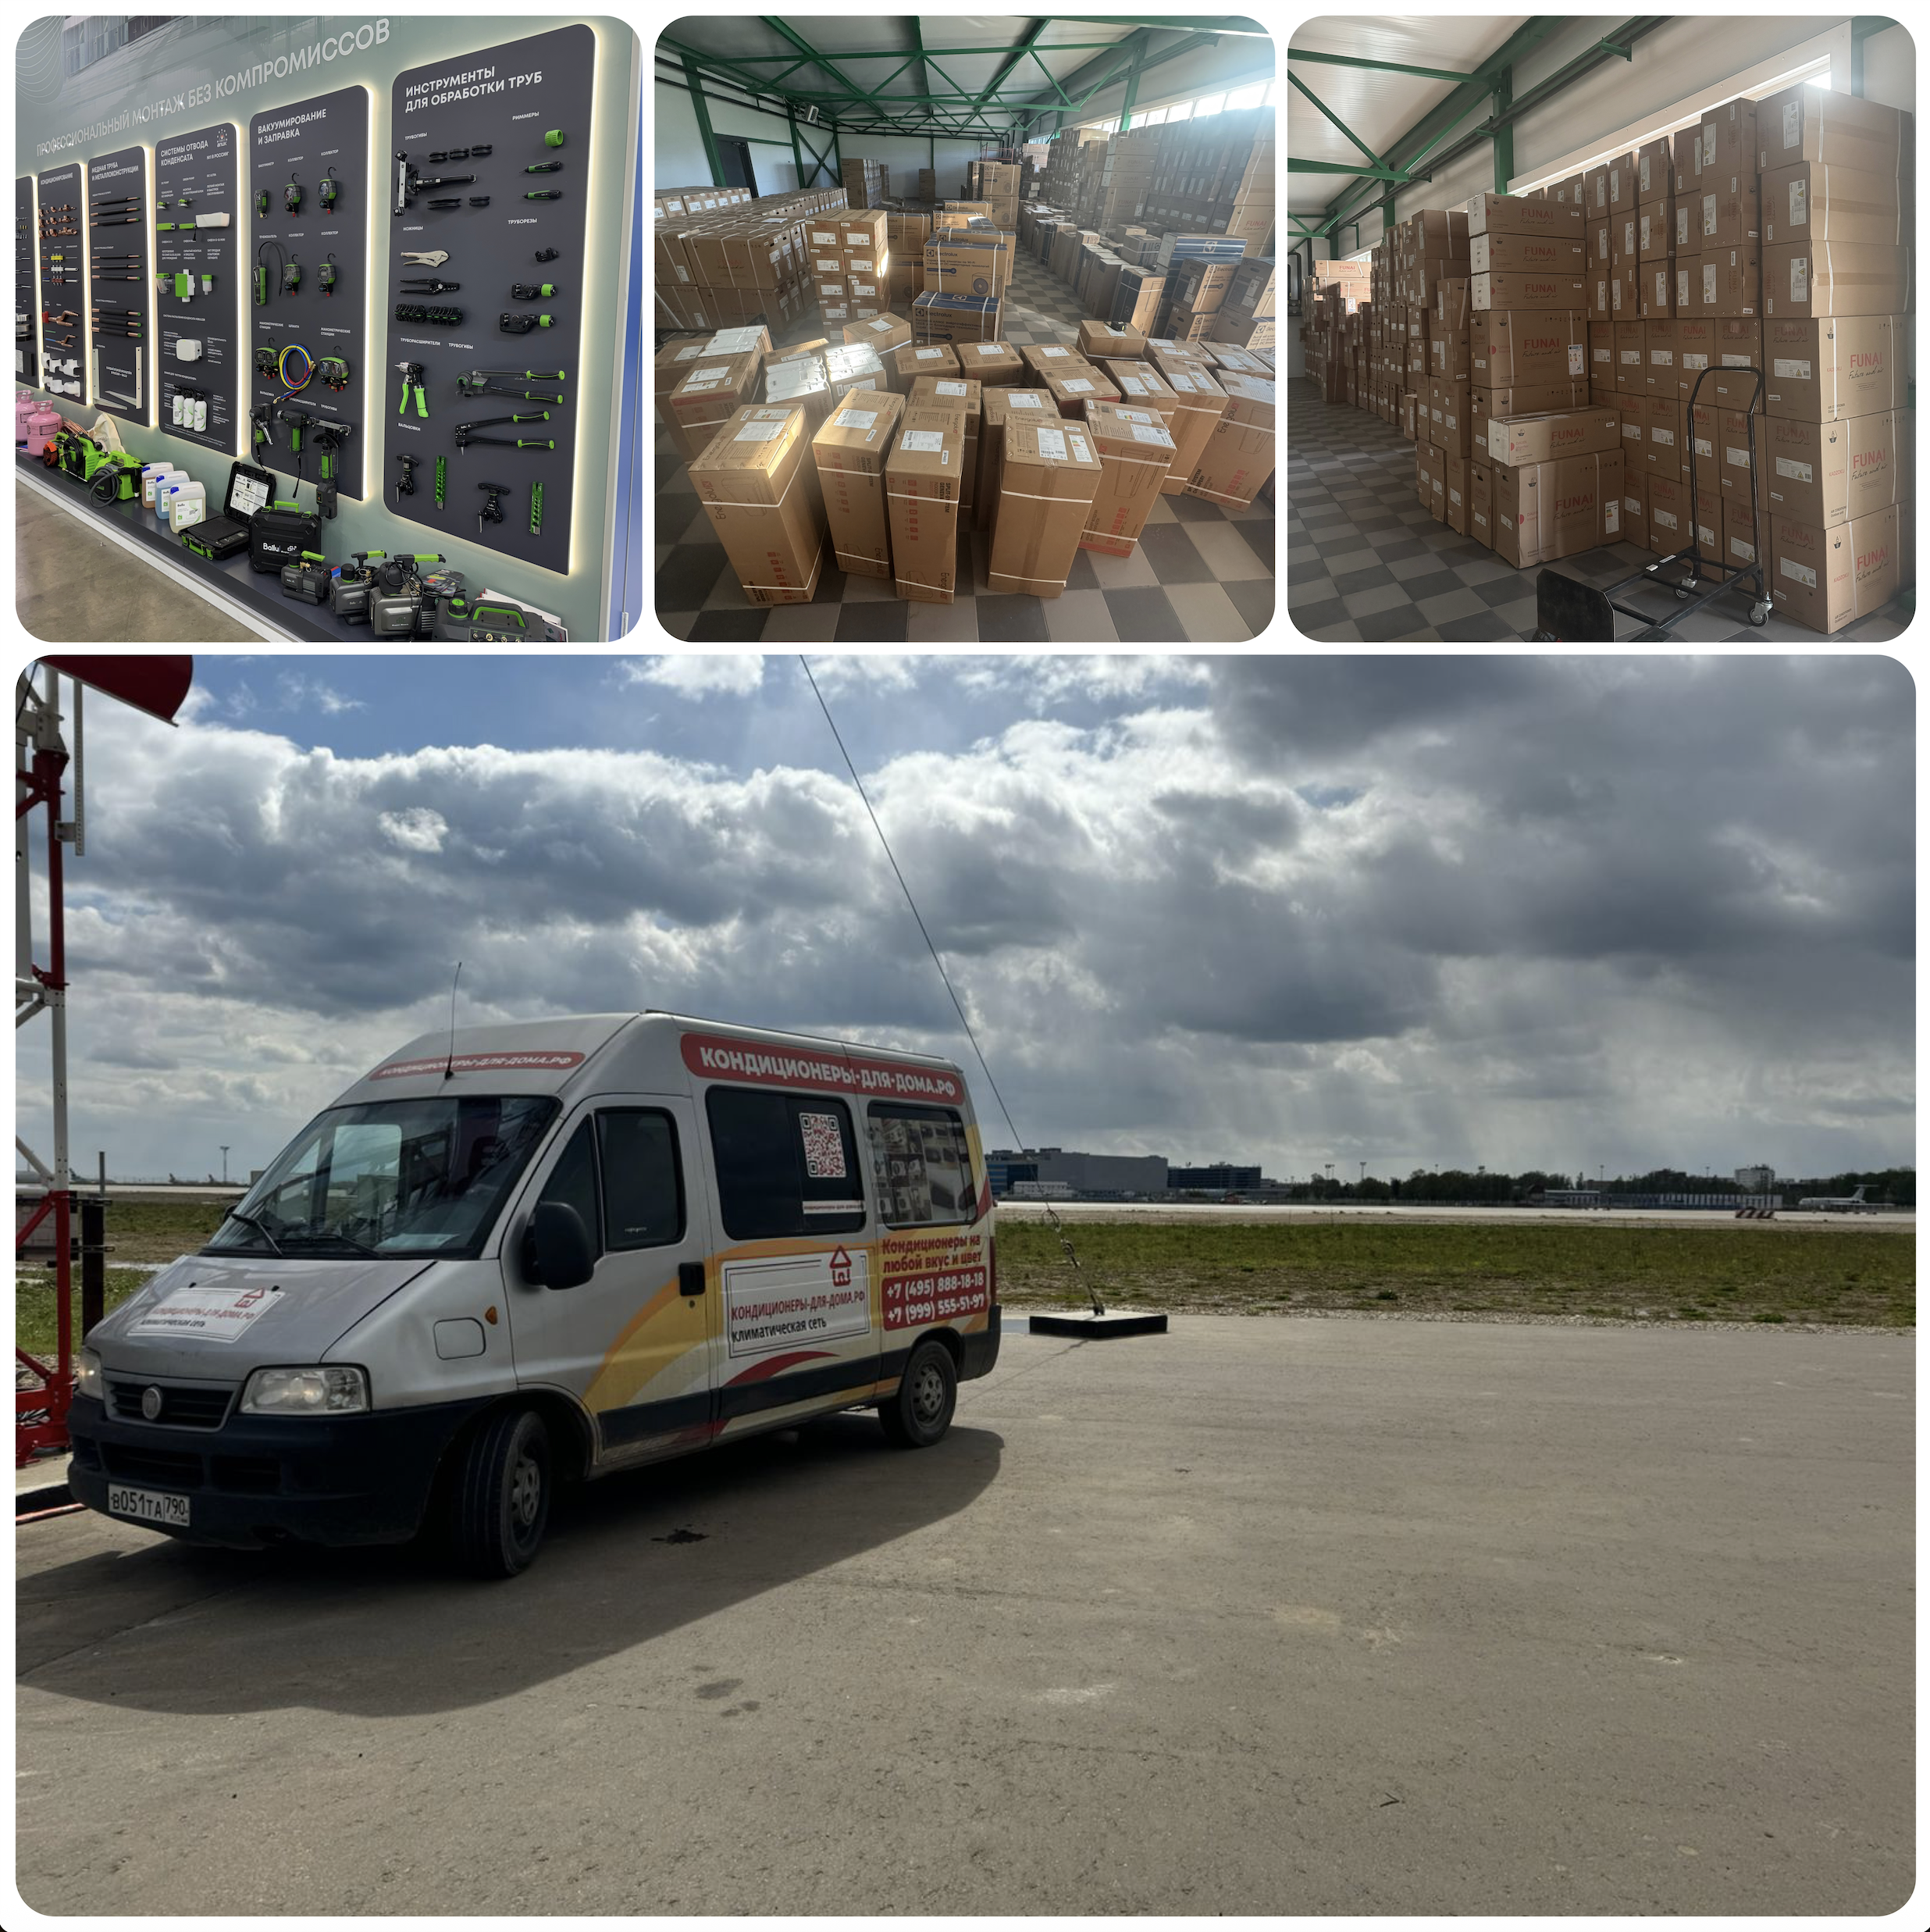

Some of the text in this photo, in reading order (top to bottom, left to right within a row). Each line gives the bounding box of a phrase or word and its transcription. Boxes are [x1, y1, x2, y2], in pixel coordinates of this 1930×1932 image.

[37, 18, 390, 157] ПРОФЕССИОНАЛЬНЫЙ МОНТАЖ БЕЗ КОМПРОМИССОВ
[405, 66, 496, 98] ИНСТРУМЕНТЫ
[405, 71, 543, 113] ДЛЯ ОБРАБОТКИ ТРУБ
[258, 109, 326, 134] ВАКУУМИРОВАНИЕ
[512, 111, 539, 121] РИММЕРЫ
[258, 127, 300, 145] И ЗАПРАВКА
[404, 132, 428, 141] ТРУБОГИБЫ
[160, 141, 208, 157] СИСТЕМЫ ОТВОДА
[91, 162, 118, 173] МЕДНАЯ ТРУБА
[161, 154, 194, 166] КОНДЕНСАТА
[40, 173, 73, 185] КОНДИЦИОНИРОВАНИЕ
[94, 165, 139, 180] МЕТАЛЛОКОНСТРУКЦИИ
[1521, 208, 1554, 219] FUNAI
[1524, 246, 1556, 256] FUNAI
[1525, 283, 1557, 293] FUNAI
[1722, 325, 1749, 334] FUNAI
[1774, 326, 1807, 337] FUNAI
[400, 337, 441, 346] ТРУБОРАСШИРИТЕЛИ
[1524, 337, 1560, 349] FUNAI
[1850, 352, 1882, 368] FUNAI
[1866, 366, 1878, 376] and
[1622, 400, 1640, 409] FUNAI
[1653, 402, 1672, 412] FUNAI
[1217, 401, 1240, 433] Enegolux
[1727, 417, 1748, 429] FUNA
[397, 422, 421, 431] ВАЛЬЦОВКИ
[1551, 428, 1584, 441] FUNAI
[1776, 425, 1809, 440] FUNAI
[1853, 448, 1885, 469] FUNAI
[1851, 470, 1868, 481] Future
[1869, 464, 1881, 475] and
[1654, 482, 1675, 495] FUNAI
[701, 480, 726, 521] Enegolux
[1555, 493, 1593, 511] FUNAI
[1782, 525, 1814, 544] FUNAI
[262, 542, 280, 553] Ballu
[875, 547, 885, 576] Enerolux
[1857, 545, 1888, 571] FUNAI
[700, 1046, 956, 1097] КОНДИЦИОНЕРЫ-ДЛЯ-ДОМА.РФ
[882, 1235, 981, 1255] Кондиционеры на
[883, 1252, 981, 1274] любой вкус и цвет
[887, 1271, 985, 1301] +7 (495) 888-18-18
[731, 1291, 865, 1321] КОНДИЦИОНЕРЫ-ДЛЯ-ДОМА.РФ
[888, 1293, 985, 1324] +7 (999) 555-51-97
[732, 1317, 827, 1343] климатическая сеть
[165, 1496, 186, 1515] 790
